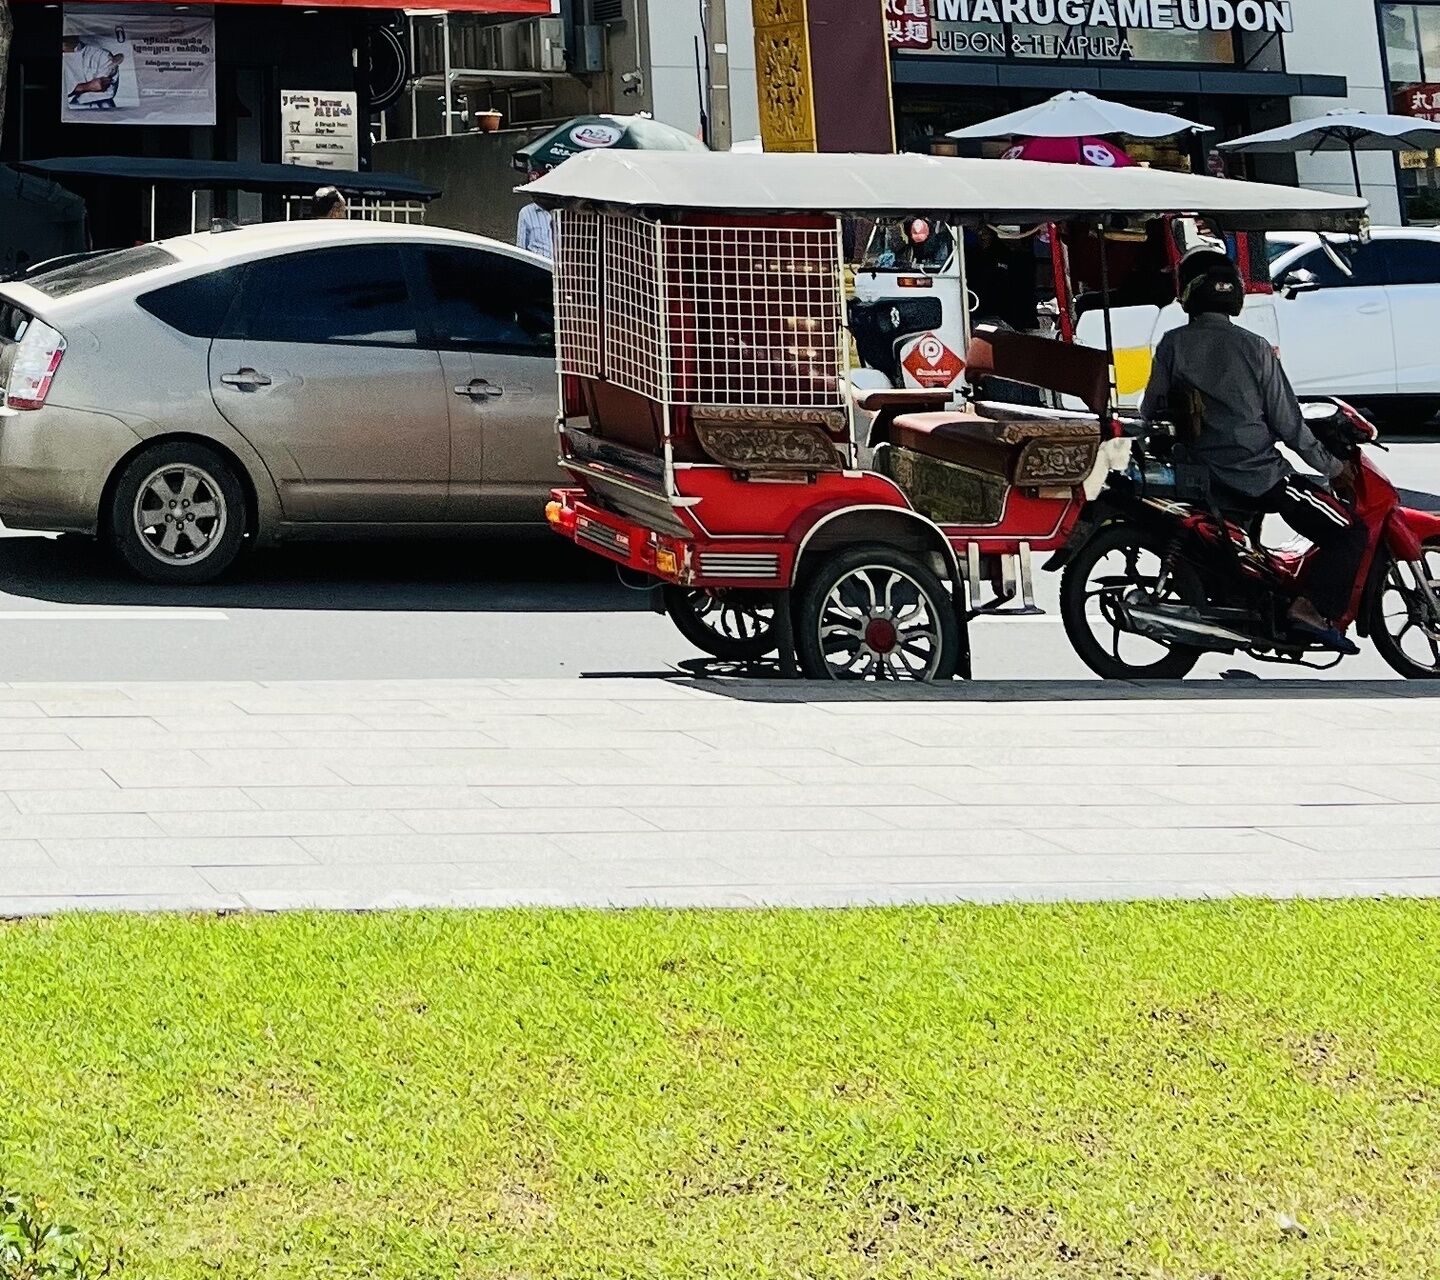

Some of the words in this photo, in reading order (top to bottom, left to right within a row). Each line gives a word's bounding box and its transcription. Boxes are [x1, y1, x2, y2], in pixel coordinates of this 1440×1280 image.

[937, 29, 1006, 54] UDON
[1010, 34, 1026, 53] &
[1031, 34, 1134, 58] TEMPURA
